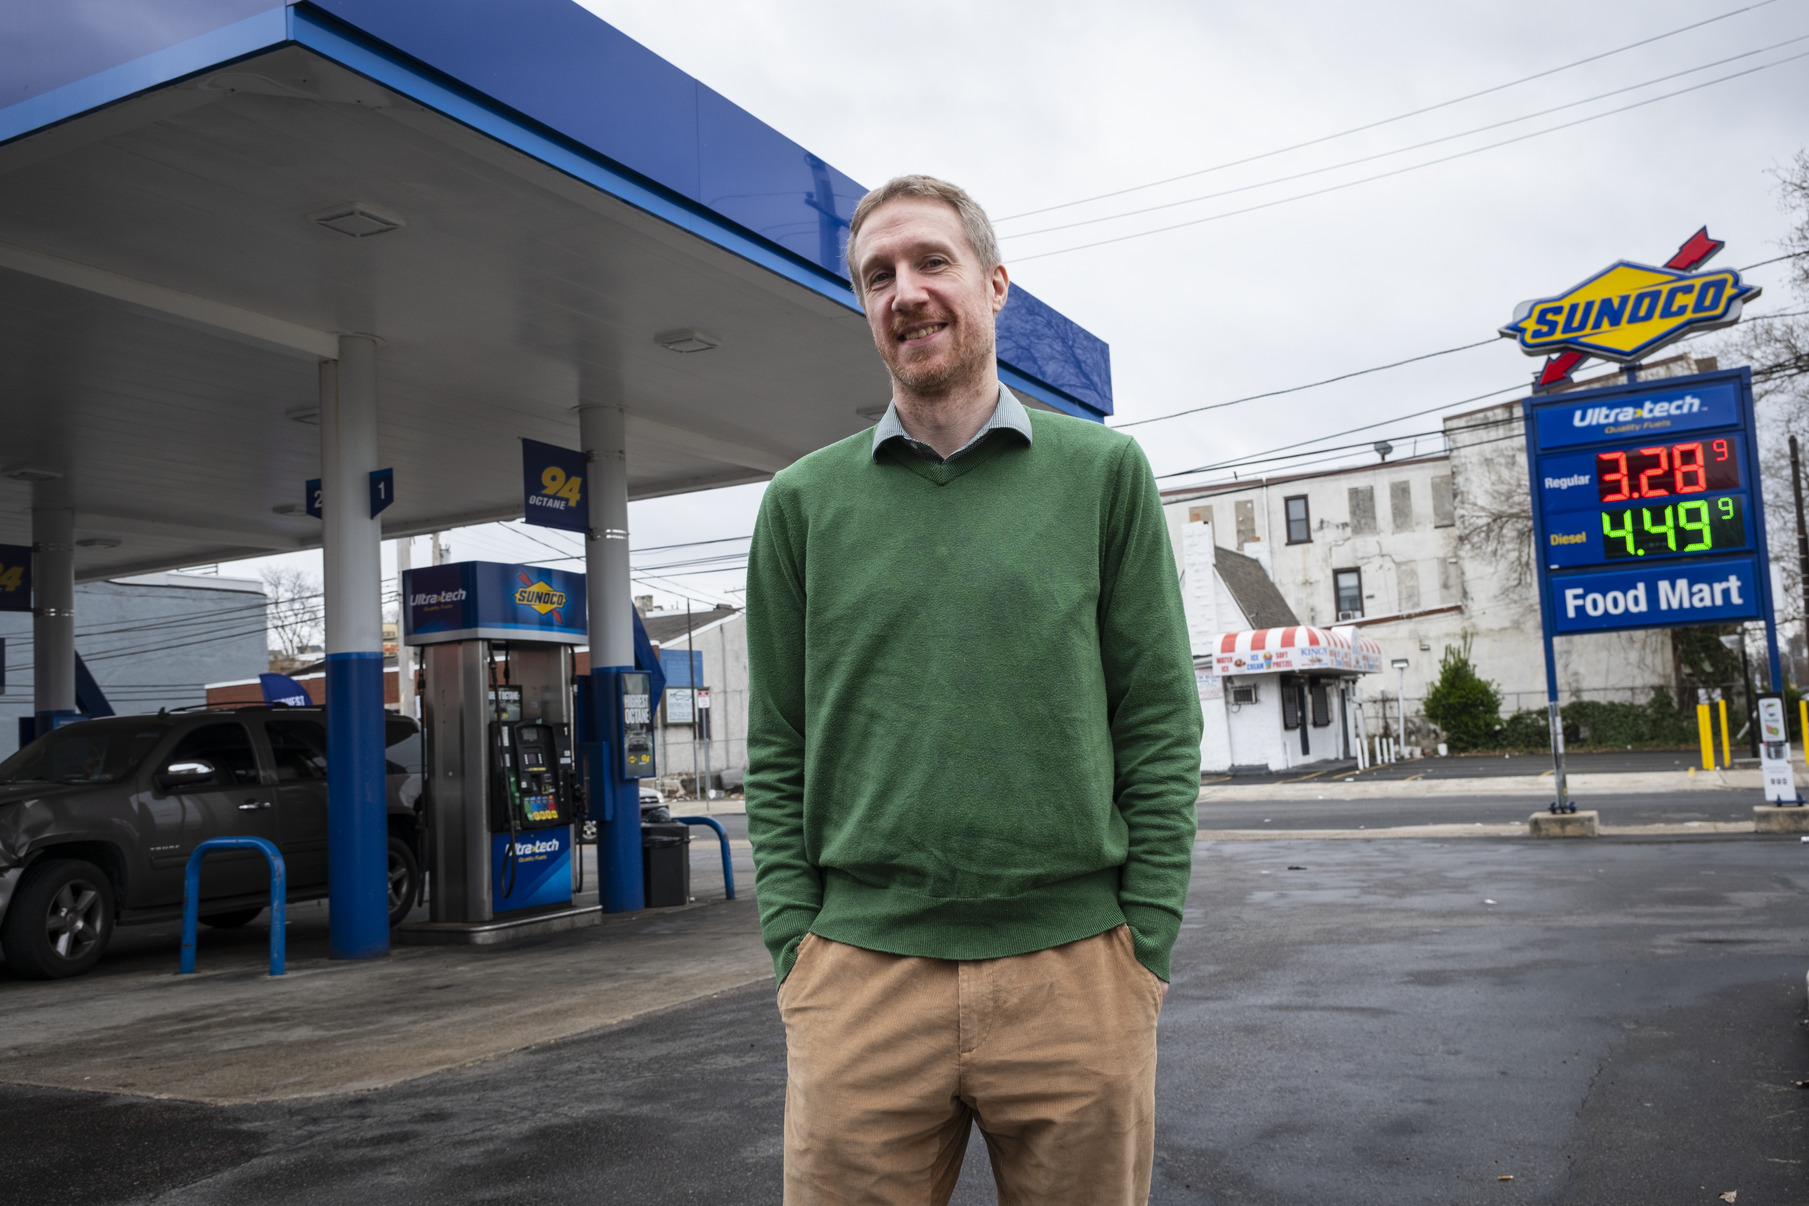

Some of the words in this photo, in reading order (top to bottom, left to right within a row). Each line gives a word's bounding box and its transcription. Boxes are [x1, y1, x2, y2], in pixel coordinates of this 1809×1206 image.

[1530, 277, 1729, 339] SUNOCO
[1604, 424, 1641, 434] Quality
[1643, 419, 1671, 430] Fuels
[541, 466, 582, 507] 94
[1544, 474, 1591, 490] Regular
[1598, 442, 1707, 502] 3.28
[378, 481, 385, 500] 1
[529, 495, 566, 510] OCTANE
[1550, 531, 1587, 546] Diesel
[1602, 500, 1712, 556] 4.49
[517, 589, 565, 607] SUNOCO
[1565, 582, 1648, 618] Food
[1658, 575, 1743, 610] Mart
[625, 708, 650, 723] OCTANE
